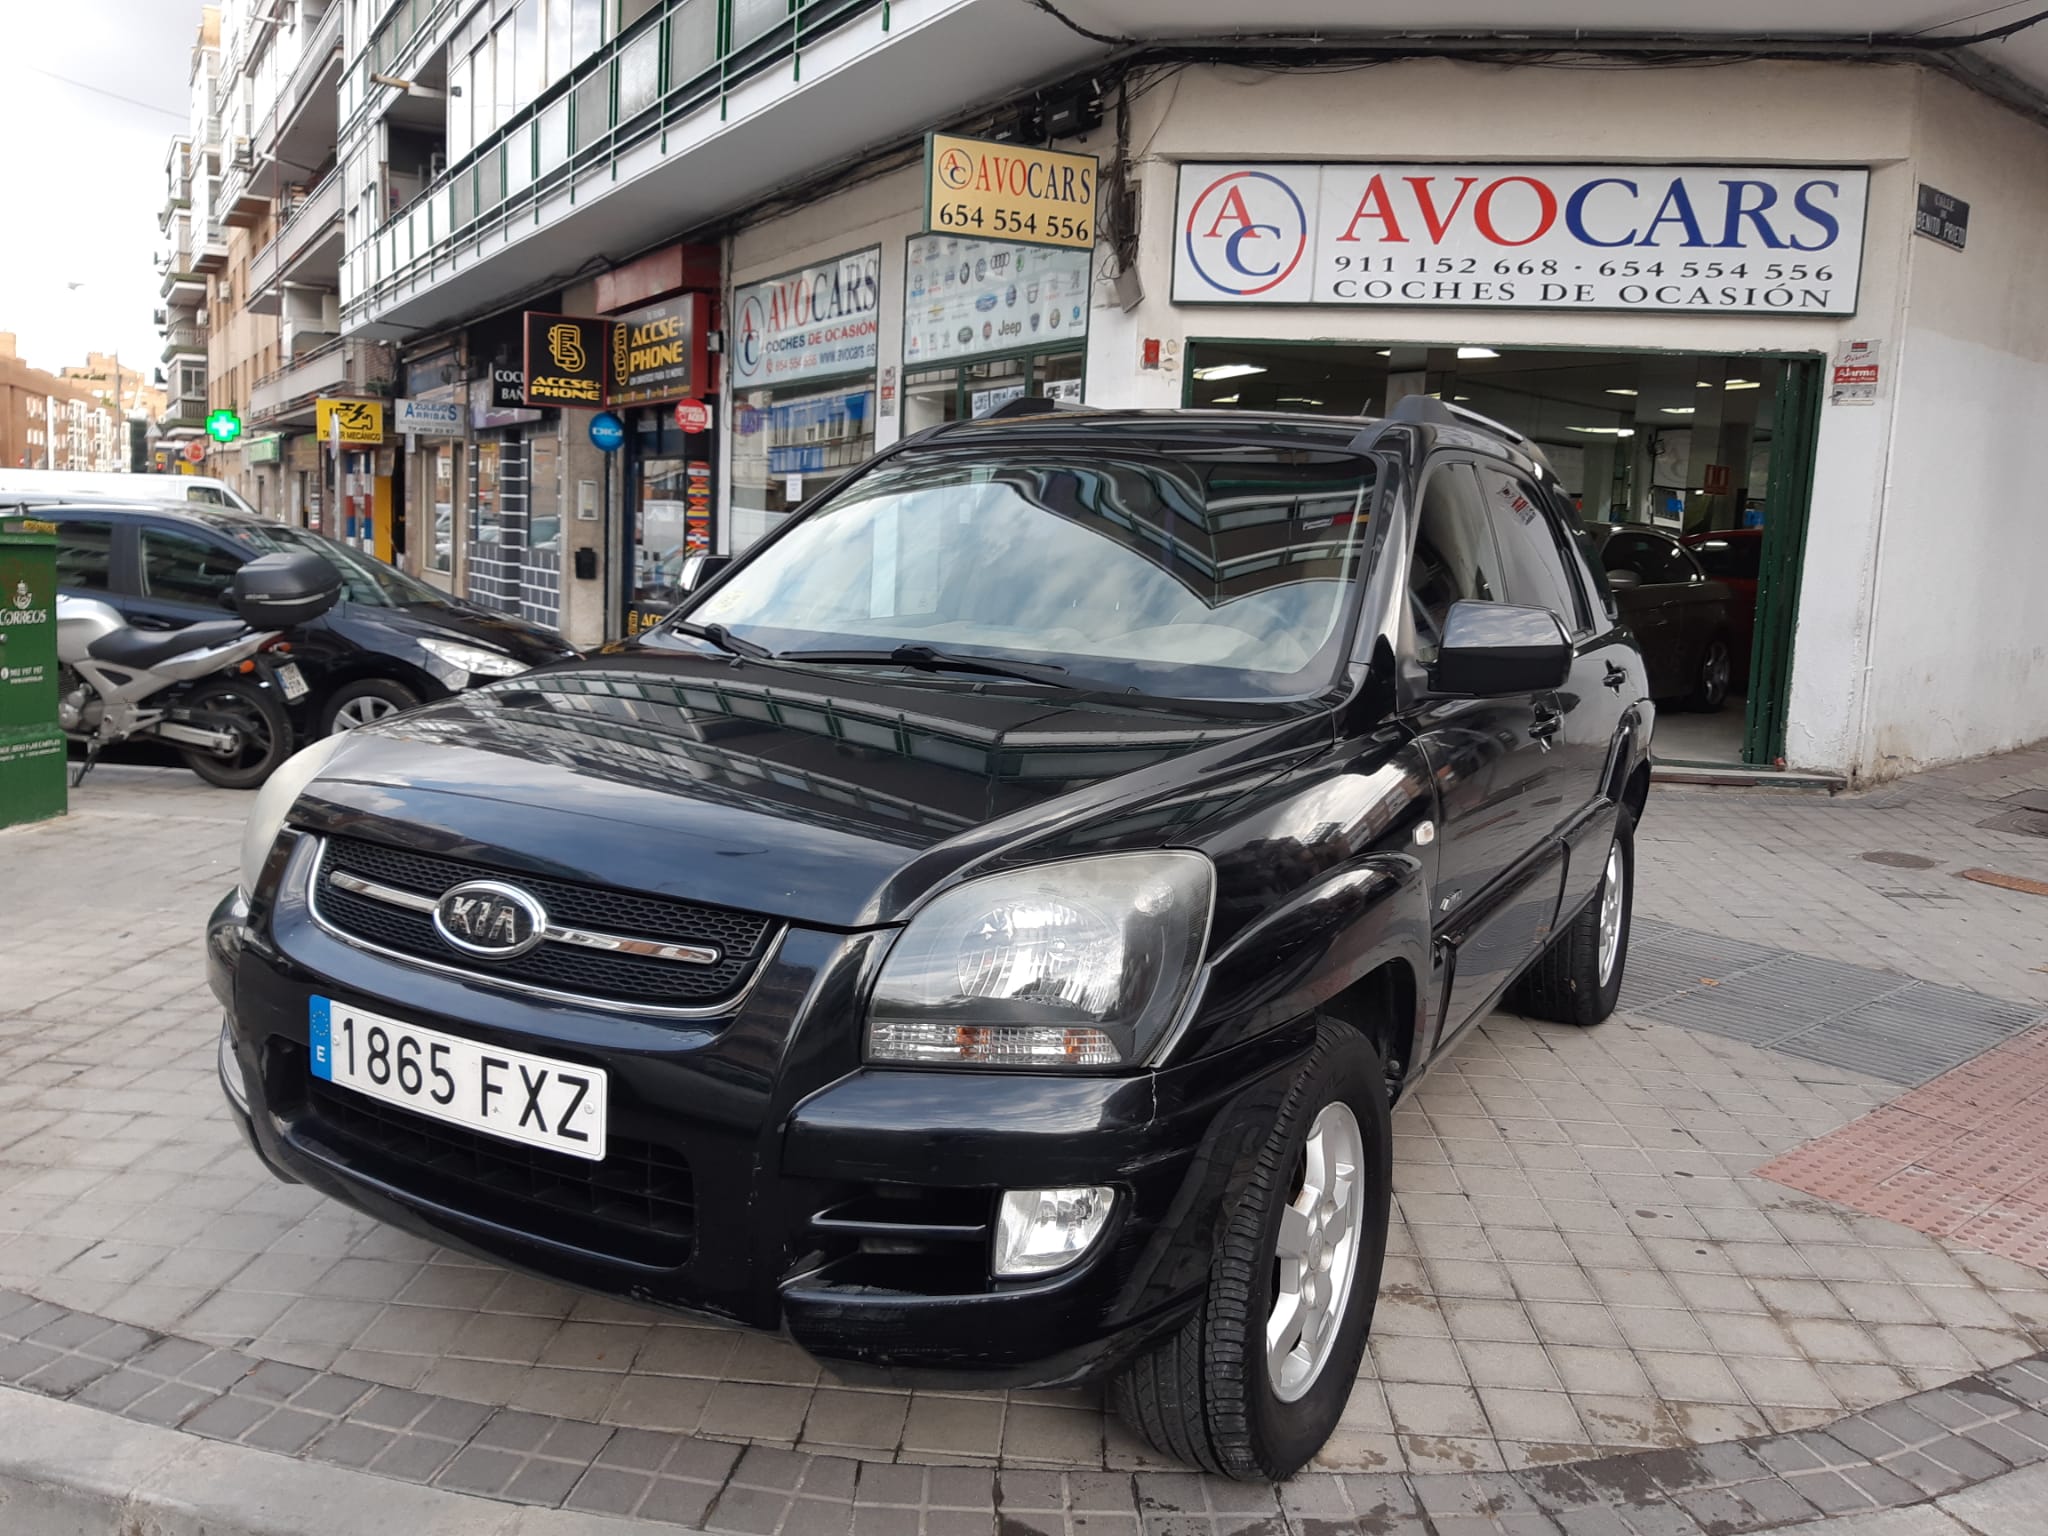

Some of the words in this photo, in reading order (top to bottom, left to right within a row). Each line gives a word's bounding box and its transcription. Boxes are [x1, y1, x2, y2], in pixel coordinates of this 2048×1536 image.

[975, 153, 1091, 204] AVOCARS
[940, 203, 984, 228] 654
[993, 209, 1037, 235] 554
[1045, 215, 1089, 241] 556
[1336, 173, 1840, 252] AVOCARS
[1335, 256, 1396, 273] 911
[1416, 256, 1478, 275] 152
[1493, 257, 1559, 276] 668
[1599, 260, 1665, 278] 654
[1680, 261, 1749, 280] 554
[1764, 263, 1834, 282] 556
[767, 257, 877, 334] AVOCARS
[1332, 280, 1516, 301] COCHES
[1539, 282, 1596, 303] DE
[1618, 283, 1832, 309] OCASIÓN
[766, 335, 806, 354] COCHES
[808, 332, 822, 346] DE
[825, 320, 877, 341] OCASIÓN
[998, 320, 1022, 336] Jeep
[629, 340, 684, 373] PHONE
[1838, 367, 1877, 377] Alarma
[531, 387, 600, 400] PHONE
[0, 608, 47, 626] CORREOS
[452, 896, 516, 944] KIA
[316, 1045, 325, 1063] E
[343, 1017, 456, 1105] 1865
[481, 1055, 590, 1142] FXZ
